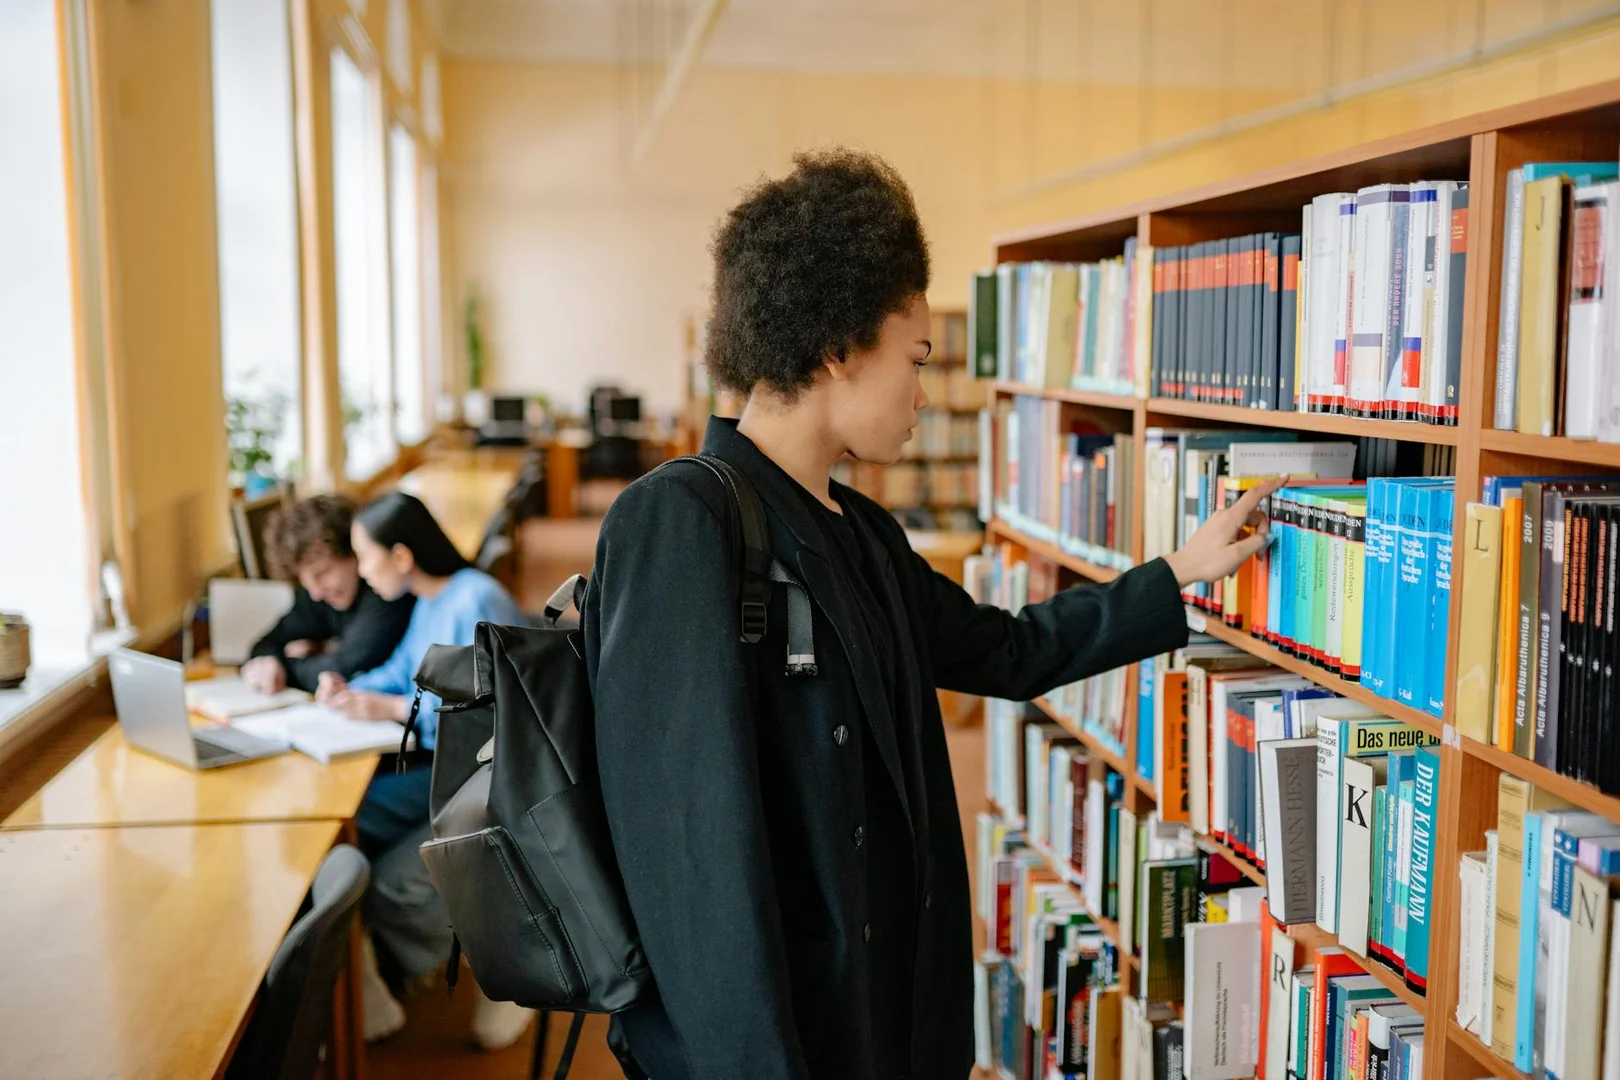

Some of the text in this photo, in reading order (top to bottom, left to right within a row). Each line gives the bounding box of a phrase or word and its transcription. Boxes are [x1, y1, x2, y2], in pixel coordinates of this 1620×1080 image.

[1474, 519, 1490, 552] L
[1523, 514, 1533, 544] 2007
[1543, 520, 1554, 550] 2009
[1330, 543, 1339, 621] Redewendungen
[1346, 549, 1355, 602] Aussprüche
[1515, 604, 1530, 727] Acta Albaruthenica 7
[1536, 612, 1551, 737] Acta Albaruthenica 9
[1357, 727, 1386, 749] Das
[1389, 731, 1424, 748] neue
[1344, 782, 1369, 830] K
[1286, 755, 1308, 913] HERMANN HESSE
[1407, 761, 1435, 925] DER KAUFMANN
[1577, 882, 1599, 934] N
[1273, 953, 1289, 992] R
